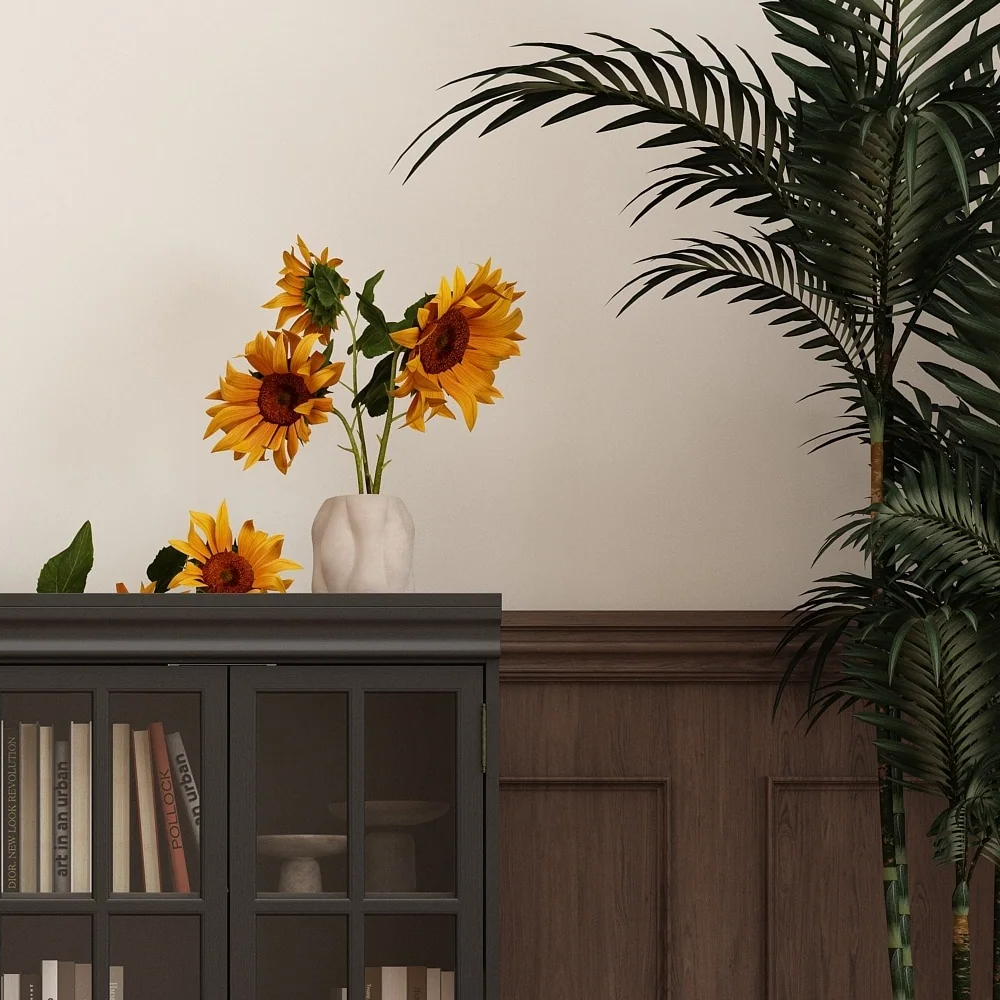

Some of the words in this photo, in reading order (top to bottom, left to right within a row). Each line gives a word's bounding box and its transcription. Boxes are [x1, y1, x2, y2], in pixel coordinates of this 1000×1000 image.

[8, 736, 17, 802] REVOLUTION
[175, 753, 198, 803] urban
[54, 761, 68, 807] urban
[8, 805, 17, 833] LOOK
[57, 811, 68, 830] an
[159, 768, 182, 850] POLLOCK
[8, 835, 17, 859] NEW
[54, 835, 68, 850] in
[8, 861, 17, 889] DIOR.
[55, 854, 68, 877] art
